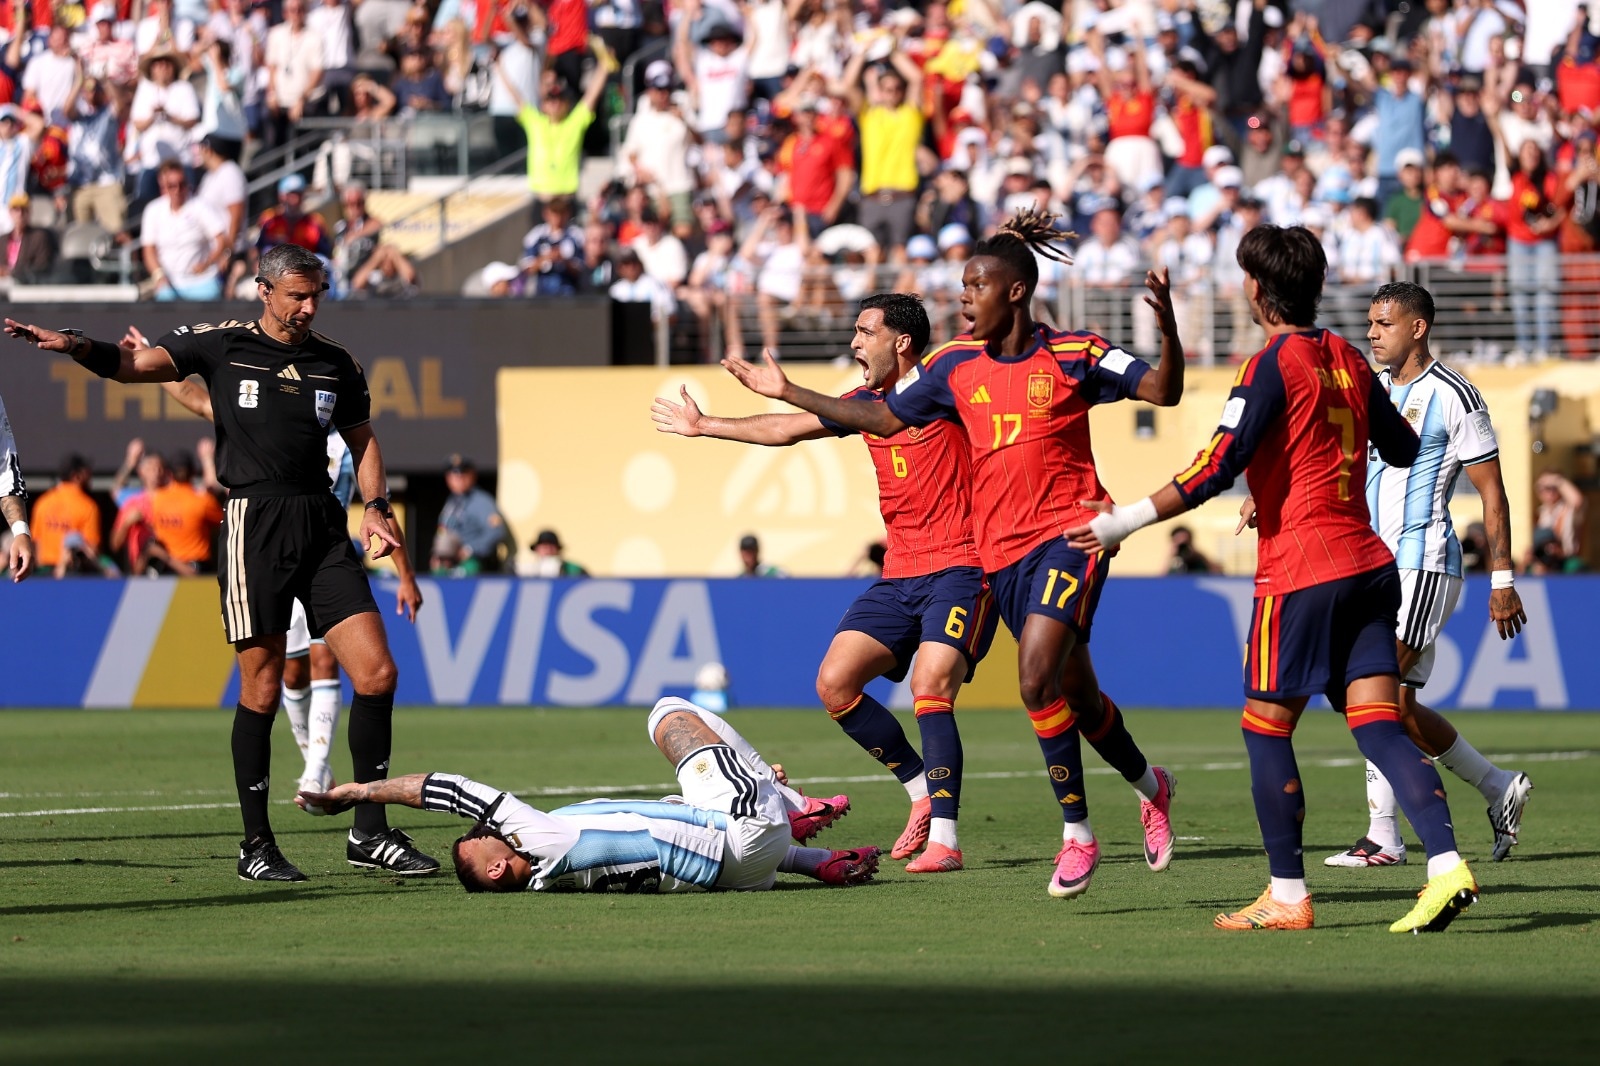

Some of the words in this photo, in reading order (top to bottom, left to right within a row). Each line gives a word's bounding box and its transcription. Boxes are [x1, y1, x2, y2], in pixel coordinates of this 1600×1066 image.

[318, 391, 336, 405] FIFA
[991, 413, 1022, 450] 17
[890, 445, 908, 478] 6
[1327, 406, 1355, 501] 7
[1040, 568, 1079, 610] 17
[944, 606, 968, 640] 6
[377, 578, 723, 706] VISA
